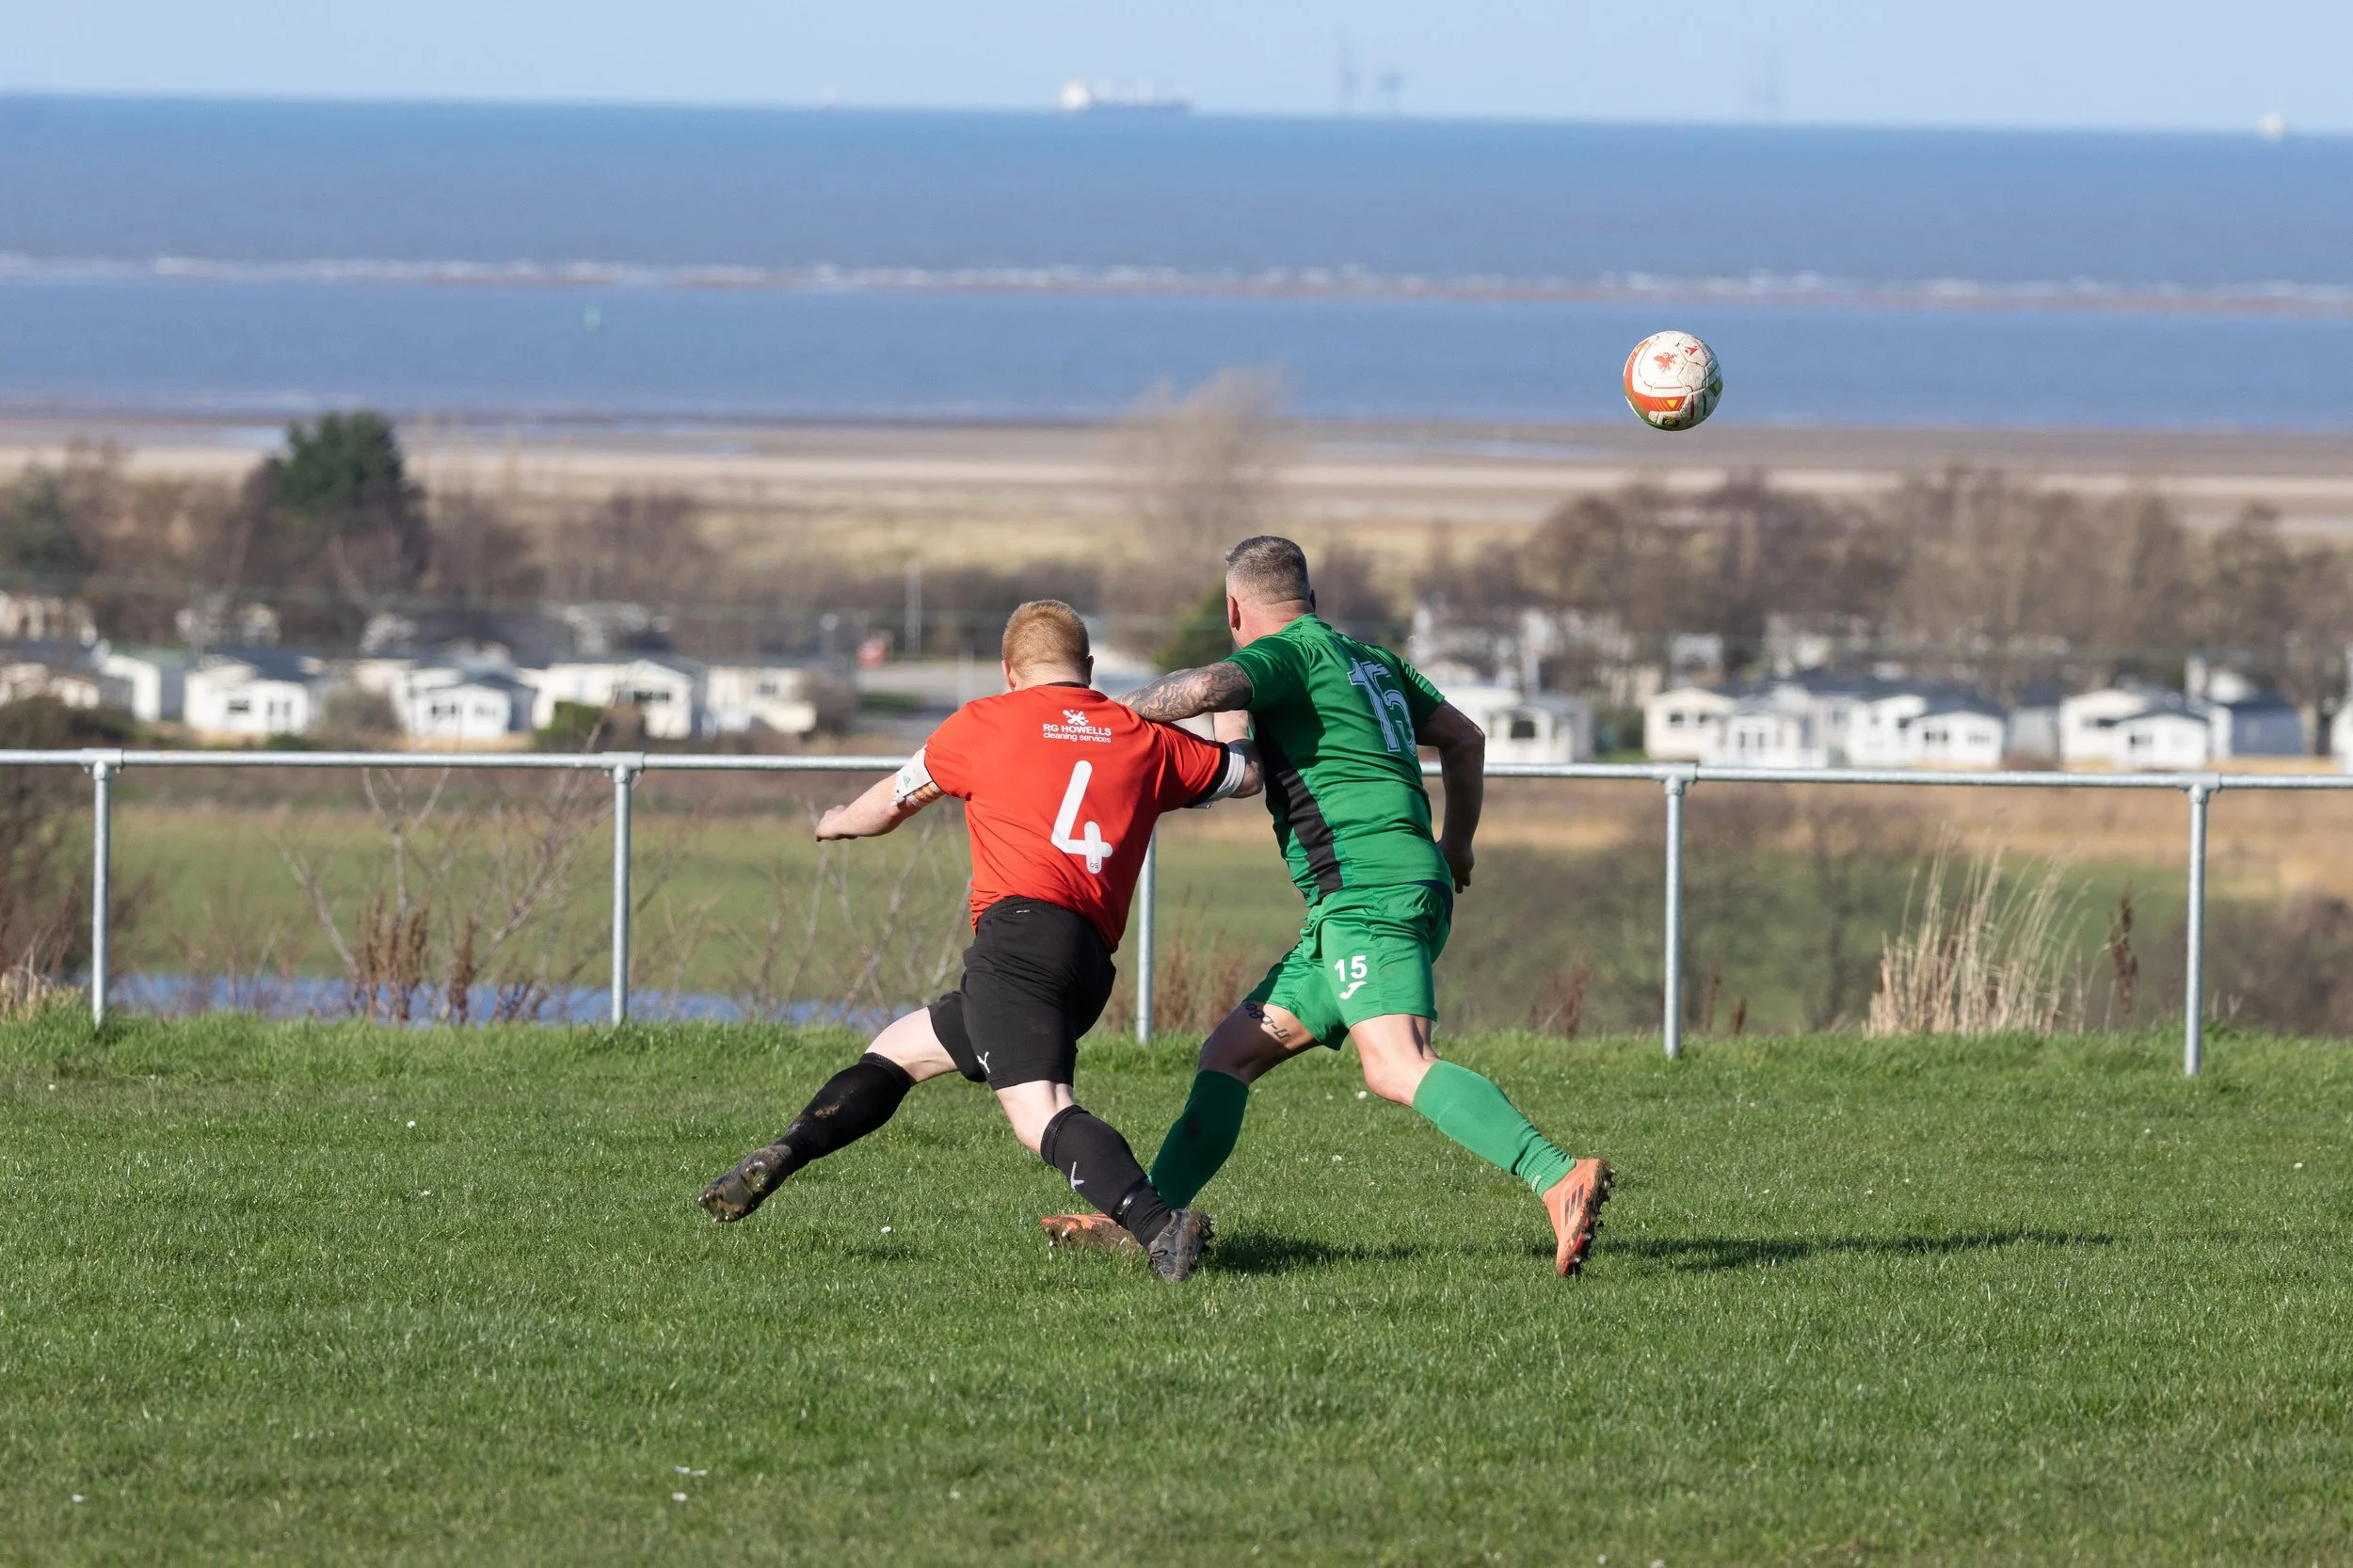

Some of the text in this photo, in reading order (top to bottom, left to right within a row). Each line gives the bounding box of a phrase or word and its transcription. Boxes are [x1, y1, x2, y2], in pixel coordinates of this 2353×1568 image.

[1347, 657, 1418, 757] 15
[1043, 723, 1112, 736] RG HOWELLS
[1043, 731, 1112, 744] cleaning services
[1050, 760, 1113, 874] 4
[1334, 955, 1368, 983] 15
